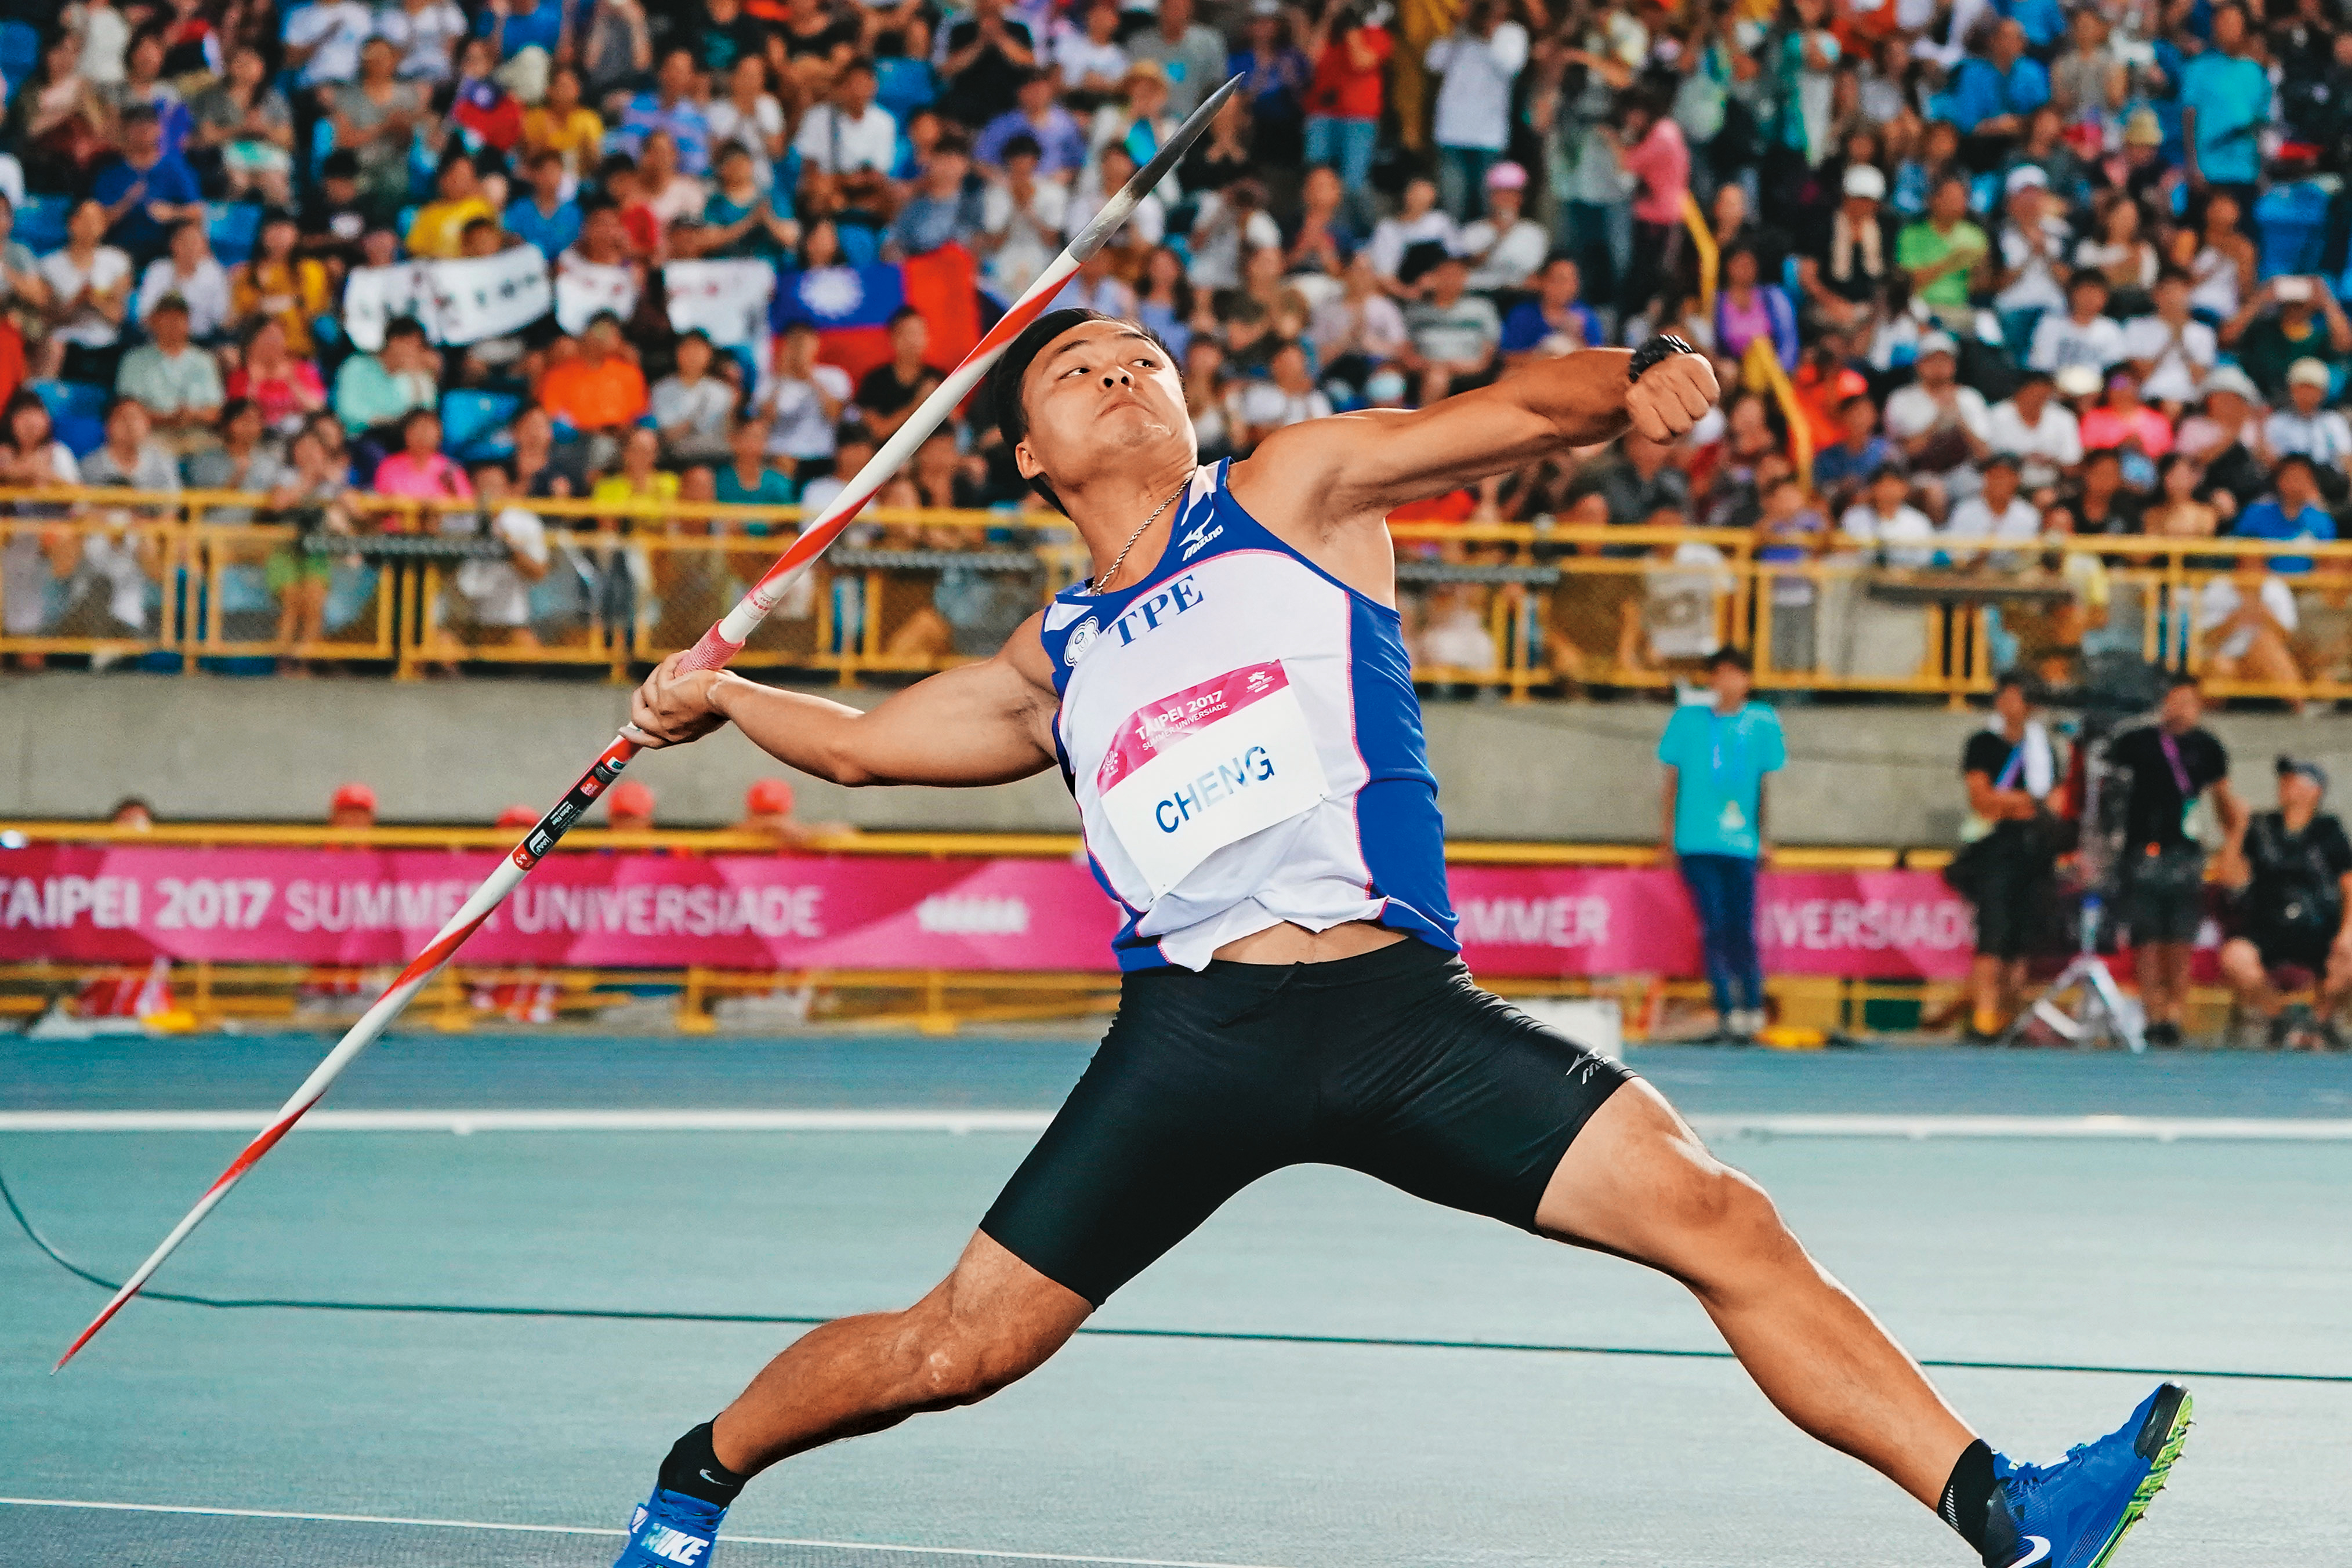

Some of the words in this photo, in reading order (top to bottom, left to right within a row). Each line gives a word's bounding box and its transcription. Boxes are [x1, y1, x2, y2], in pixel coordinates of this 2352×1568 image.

[1108, 575, 1204, 648] TPE
[1135, 706, 1184, 740] TAIPEI
[1186, 690, 1222, 713] 2017
[1142, 727, 1176, 750] SUMMER
[1176, 702, 1228, 729] UNIVERSIADE
[1155, 746, 1274, 833] CHENG
[536, 837, 549, 854] IAAF
[155, 877, 272, 929] 2017
[512, 883, 825, 937] UNIVERSIADE
[640, 1523, 709, 1566] NIKE
